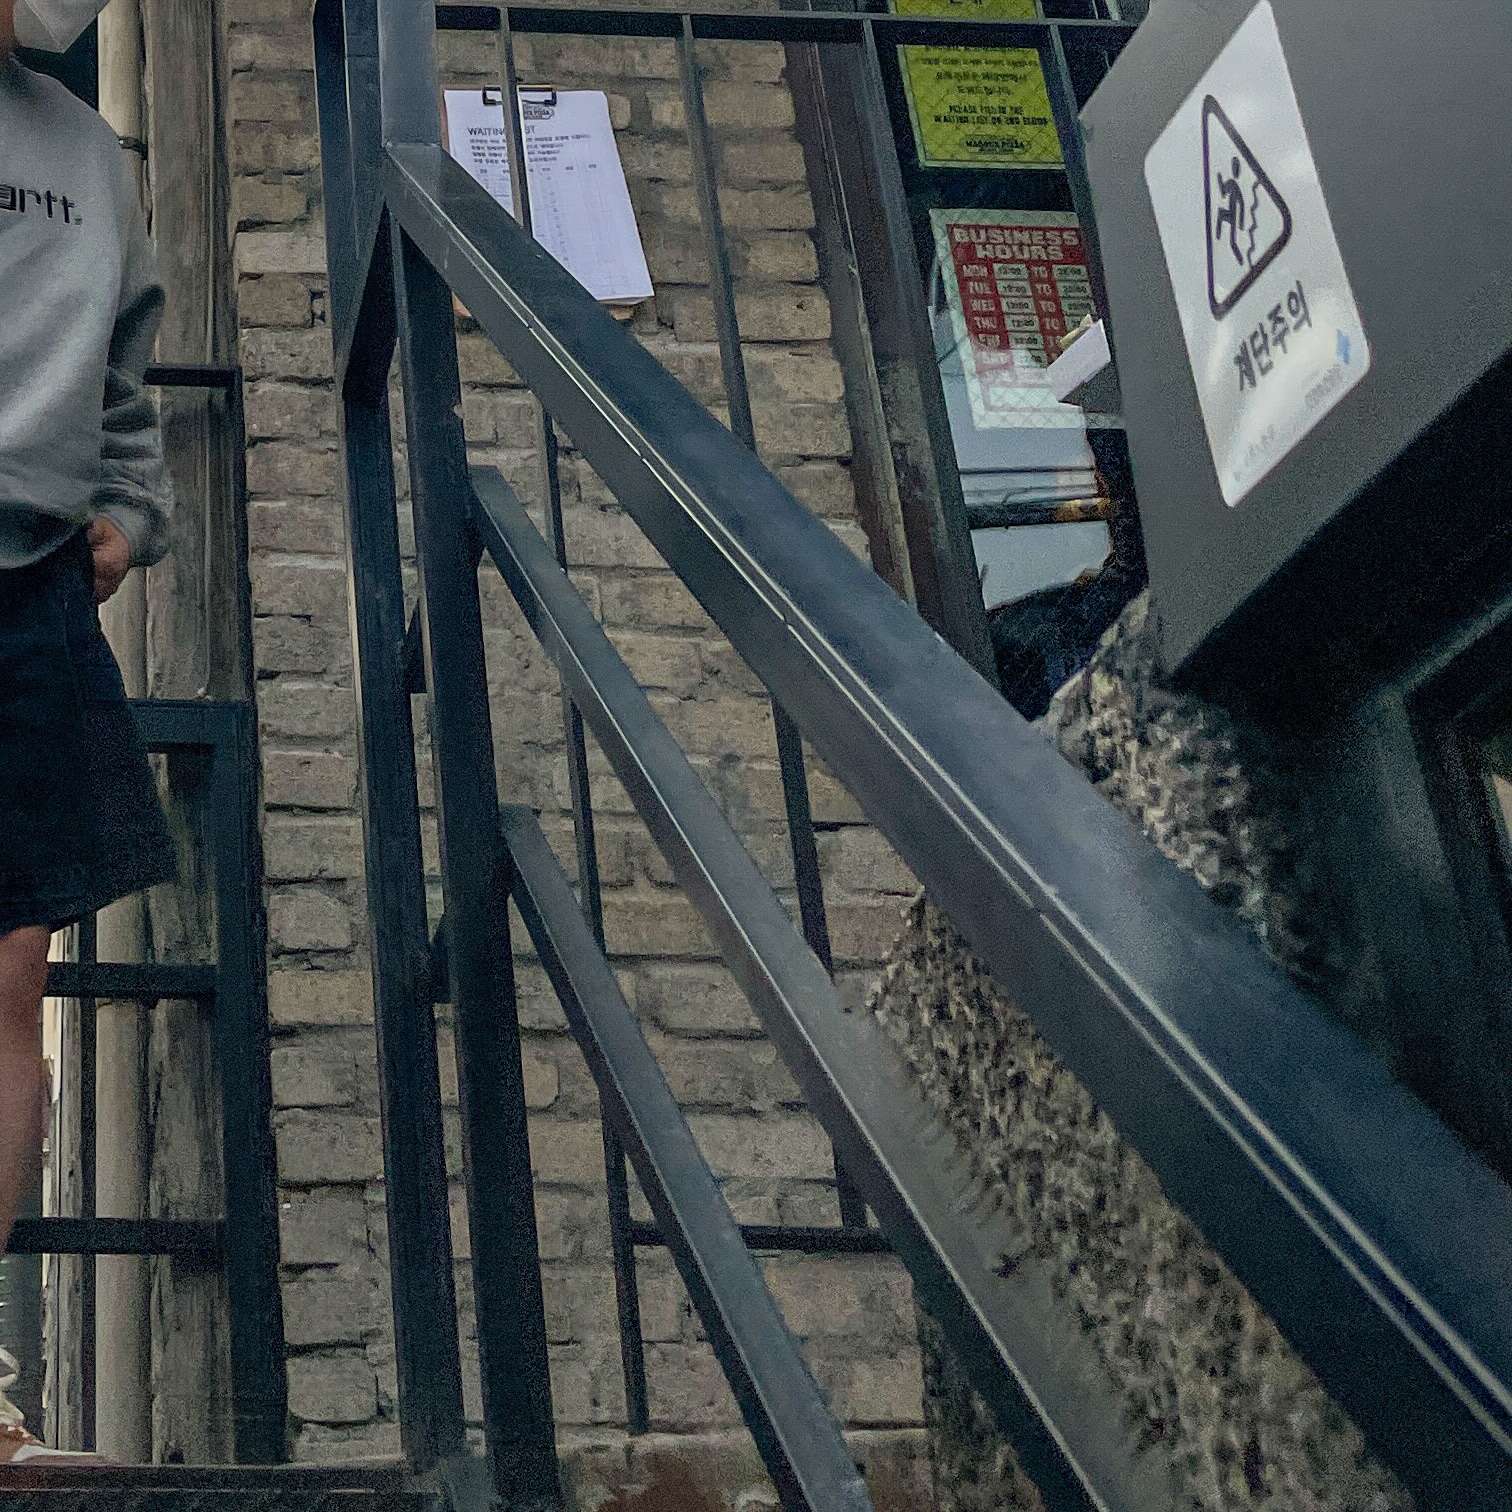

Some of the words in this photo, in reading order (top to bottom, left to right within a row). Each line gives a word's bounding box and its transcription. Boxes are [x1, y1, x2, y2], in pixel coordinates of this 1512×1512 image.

[467, 127, 504, 136] WAITIN
[953, 228, 1080, 245] BUSINESS
[974, 243, 1064, 260] HOURS
[1233, 280, 1313, 391] 계단주의
